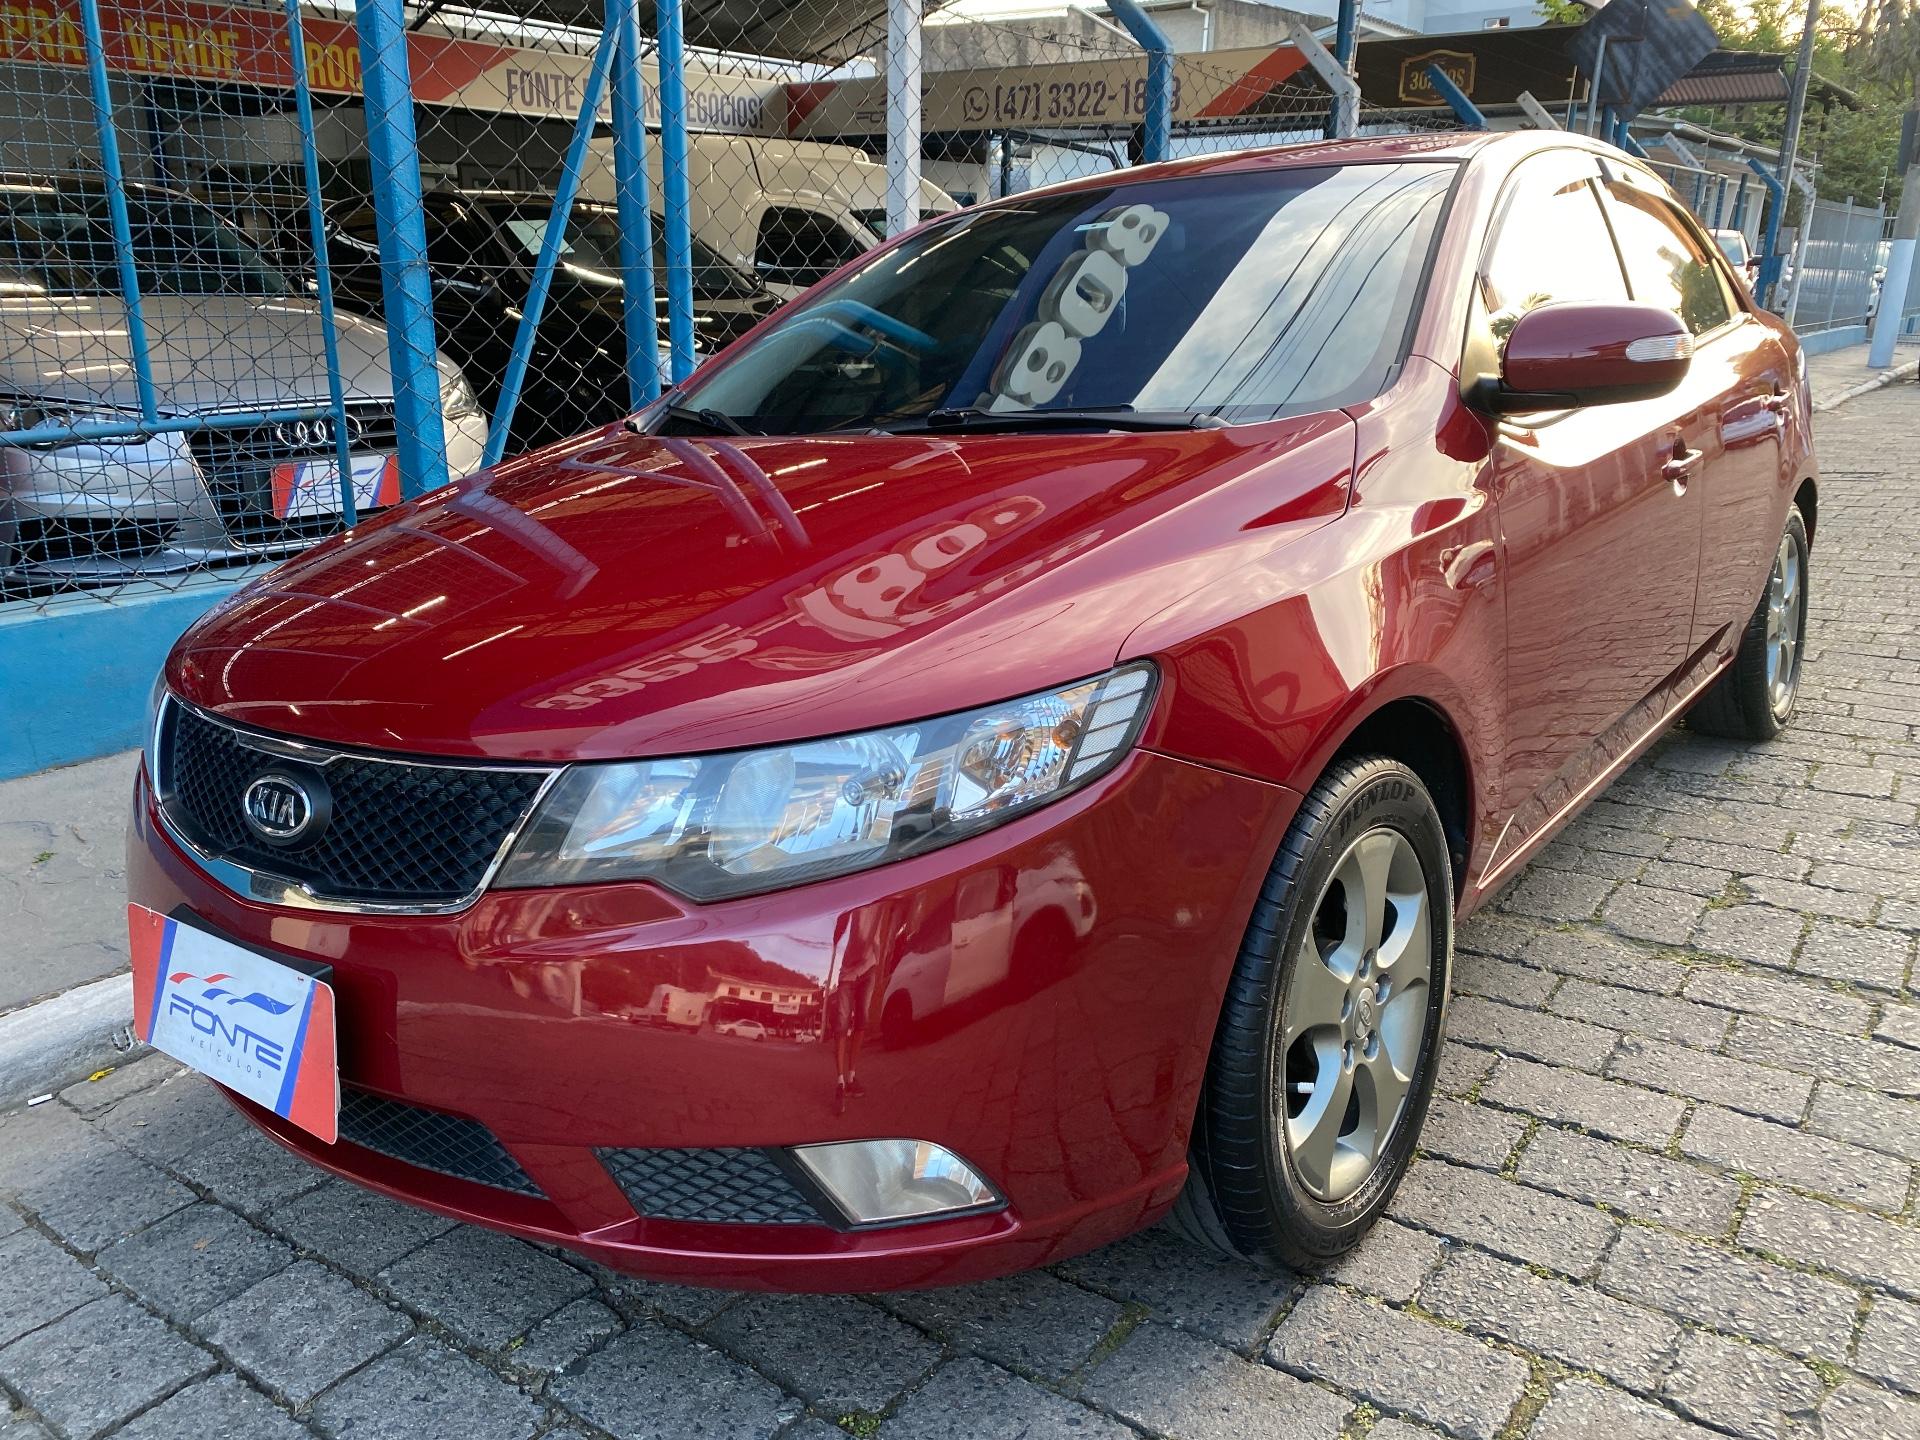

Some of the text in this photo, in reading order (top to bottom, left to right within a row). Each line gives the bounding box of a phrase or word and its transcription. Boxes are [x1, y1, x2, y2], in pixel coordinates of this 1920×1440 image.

[0, 5, 83, 60] PRA
[285, 38, 363, 88] ROC
[506, 69, 578, 111] FONTE
[686, 86, 764, 129] EGÓCIOS!
[252, 785, 296, 828] KIA
[1337, 779, 1417, 840] DUNLOP
[168, 992, 284, 1071] FONTE
